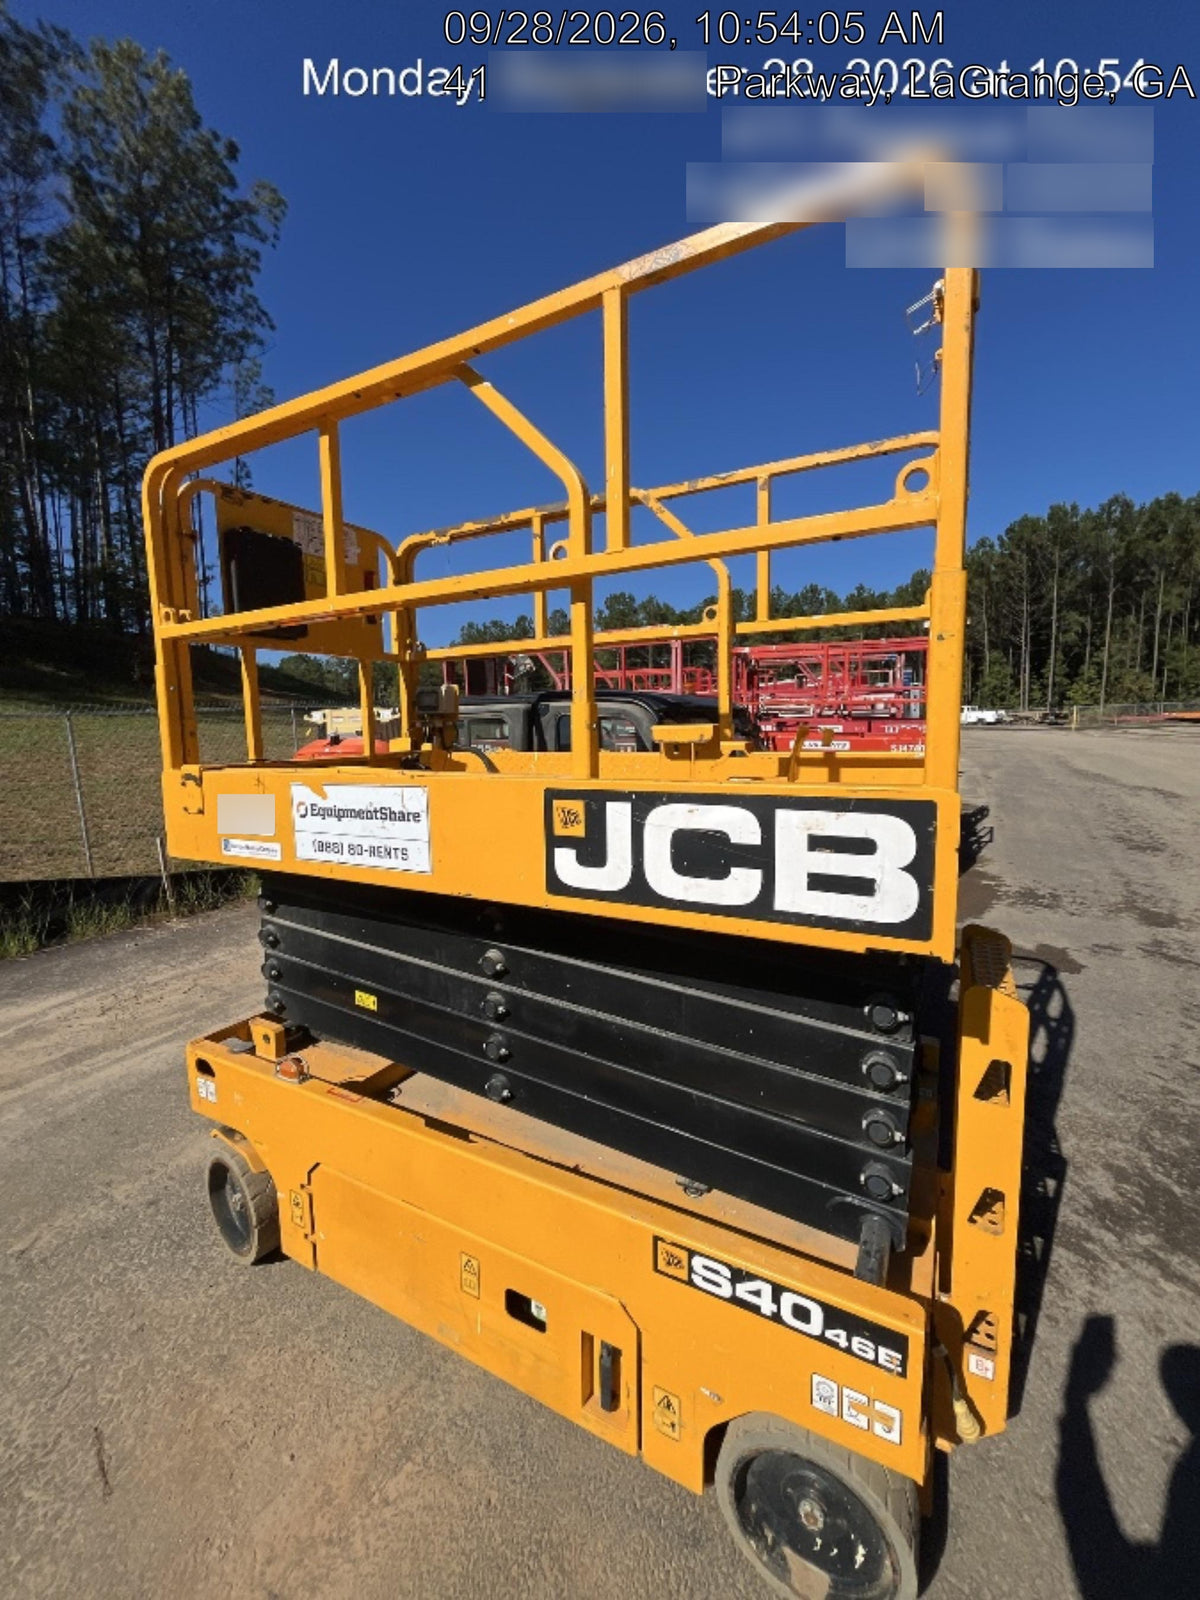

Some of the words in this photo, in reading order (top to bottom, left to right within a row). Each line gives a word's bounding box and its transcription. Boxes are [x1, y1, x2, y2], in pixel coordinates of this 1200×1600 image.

[310, 802, 422, 824] EquipmentShare
[347, 842, 409, 861] 80-RENTS
[554, 801, 920, 923] JCB
